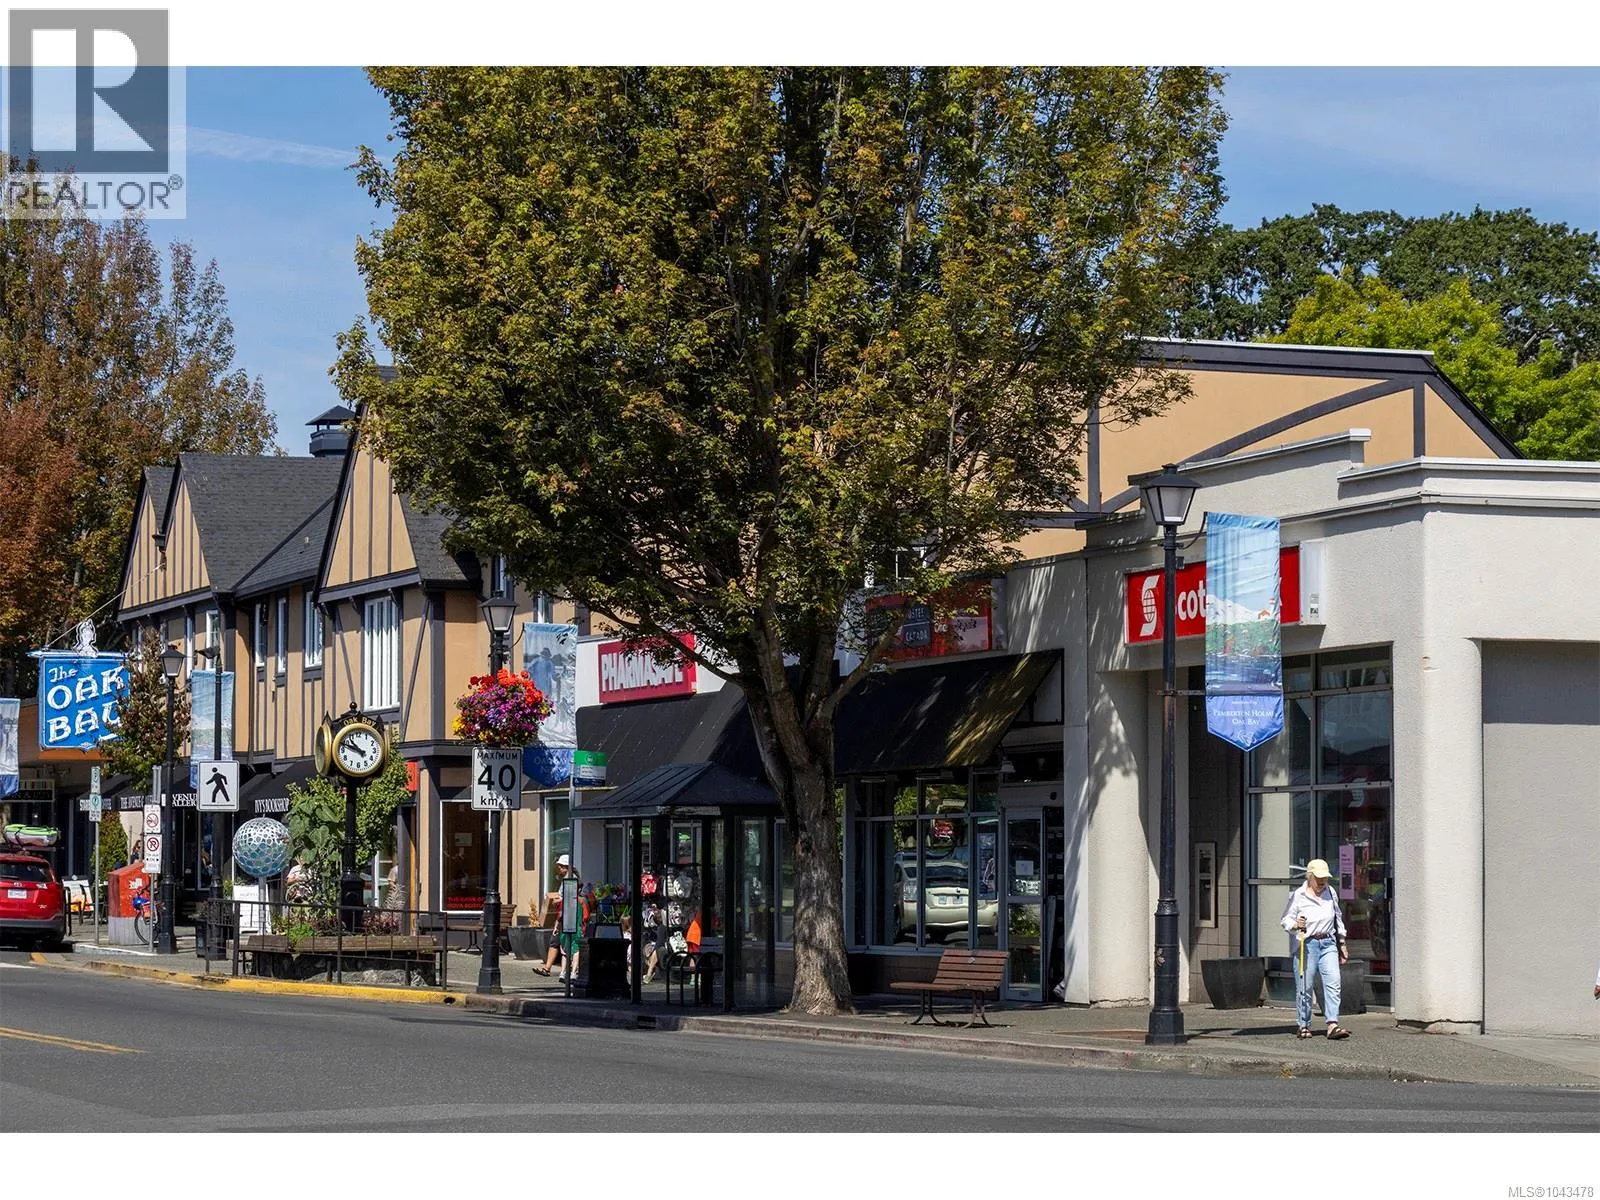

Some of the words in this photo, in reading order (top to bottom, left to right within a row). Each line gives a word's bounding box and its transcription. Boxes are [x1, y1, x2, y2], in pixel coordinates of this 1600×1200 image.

[48, 665, 79, 682] The
[47, 666, 126, 710] OAK
[1251, 709, 1275, 717] HOLM
[343, 717, 358, 726] Oak
[362, 717, 376, 727] Bay
[477, 752, 518, 760] MAXIMUM
[478, 764, 516, 791] 40
[172, 793, 197, 801] VENU
[480, 795, 513, 807] km/h
[172, 799, 197, 807] ALLER
